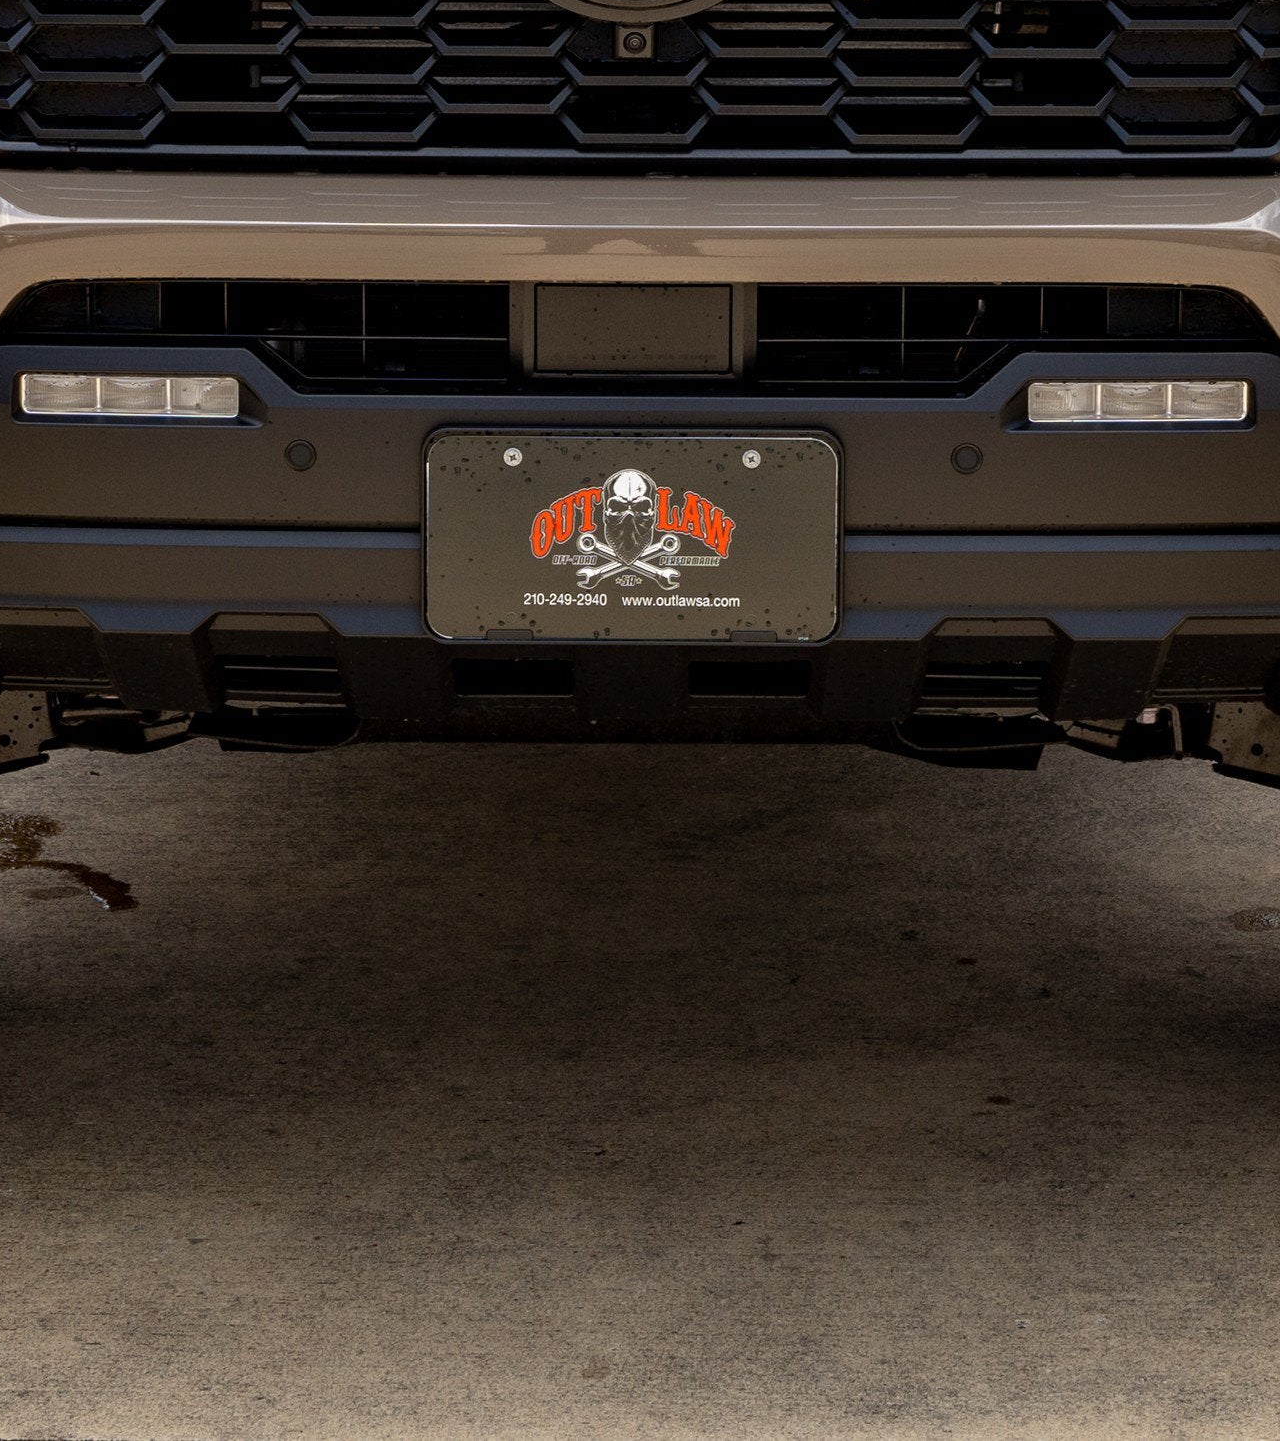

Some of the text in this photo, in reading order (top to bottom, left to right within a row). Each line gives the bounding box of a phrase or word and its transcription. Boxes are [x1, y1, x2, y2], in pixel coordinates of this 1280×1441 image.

[552, 555, 720, 567] OFF-ROAD PERFORMANCE
[523, 592, 740, 609] 210-249-2940 www.outlawsa.com
